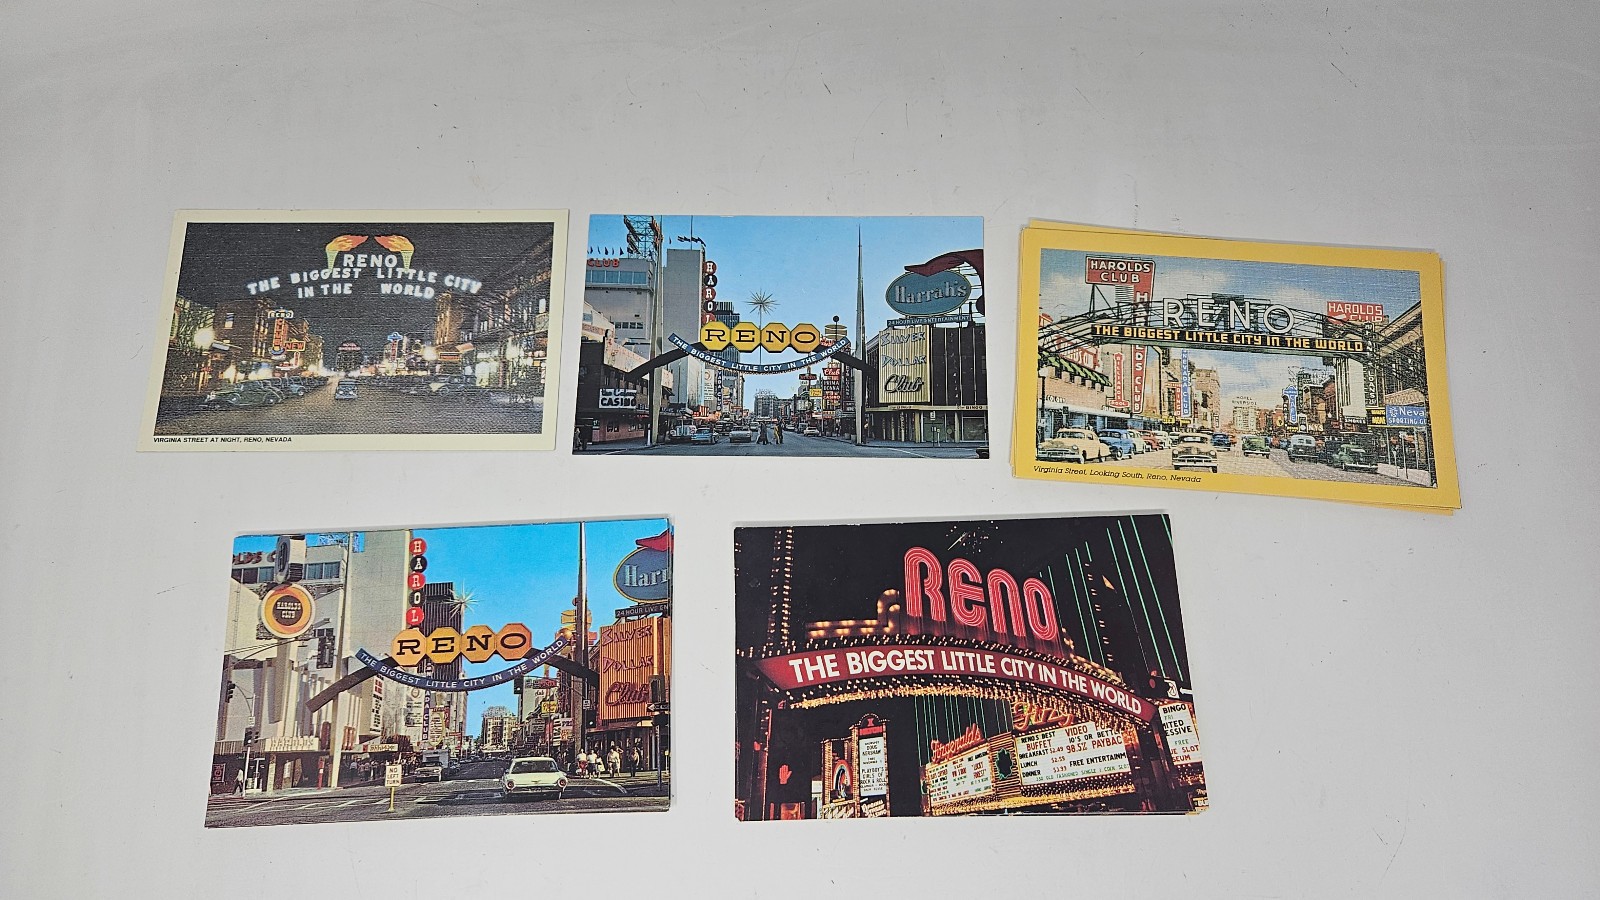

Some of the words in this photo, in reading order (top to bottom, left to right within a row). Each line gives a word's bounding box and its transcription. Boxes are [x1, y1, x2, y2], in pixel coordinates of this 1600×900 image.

[343, 254, 397, 268] RENO
[587, 258, 620, 268] CLUB
[1090, 260, 1151, 273] HAROLDS
[246, 277, 281, 295] THE
[290, 268, 361, 284] BIGGEST
[376, 268, 438, 283] LITTLE
[444, 275, 482, 294] CITY
[1100, 272, 1140, 283] CLUB
[297, 287, 315, 299] IN
[320, 283, 352, 295] THE
[381, 283, 436, 299] WORLD
[895, 280, 967, 304] Harrah's
[1328, 303, 1382, 315] HAROLDS
[1163, 298, 1295, 334] RENO
[705, 329, 816, 343] RENO
[1094, 325, 1120, 336] THE
[1124, 327, 1180, 340] BIGGEST
[1185, 331, 1229, 343] LITTLE
[1233, 334, 1262, 346] CITY
[1266, 336, 1280, 346] IN
[1285, 337, 1310, 348] THE
[1315, 339, 1364, 352] WORLD
[673, 336, 687, 350] THE
[690, 348, 727, 366] BIGGEST
[731, 362, 758, 372] LITTLE
[764, 364, 782, 372] CITY
[801, 356, 817, 366] THE
[820, 339, 847, 358] WORLD
[1134, 377, 1143, 411] CLUB
[600, 397, 637, 407] CASINO
[1399, 406, 1425, 417] Neva
[1033, 466, 1063, 474] Virginia
[1090, 469, 1120, 478] Looking
[1121, 471, 1144, 479] South,
[1170, 474, 1202, 483] Nevada
[617, 609, 625, 617] 24
[625, 607, 644, 616] HOUR
[601, 626, 653, 647] SILVER
[396, 632, 527, 656] RENO
[360, 652, 377, 668] THE
[380, 665, 421, 685] BIGGEST
[426, 679, 458, 689] LITTLE
[463, 677, 485, 687] CITY
[492, 673, 503, 682] IN
[508, 663, 528, 677] THE
[532, 639, 564, 664] WORLD
[602, 655, 654, 674] DOLLAR
[789, 654, 840, 683] THE
[846, 649, 936, 676] BIGGEST
[940, 651, 997, 674] LITTLE
[1000, 656, 1035, 680] CITY
[1038, 664, 1058, 685] IN
[1059, 669, 1088, 693] THE
[1090, 679, 1142, 715] WORLD
[1162, 703, 1187, 715] BINGO
[1041, 731, 1056, 740] BEST
[1064, 725, 1088, 737] VIDEO
[1165, 725, 1193, 737] ESSIVE
[1026, 739, 1052, 752] BUFFET
[1066, 742, 1088, 754] 98.5%
[1091, 735, 1123, 750] PAYBAC
[1182, 744, 1199, 753] SLOT
[1019, 749, 1049, 760] BREAKFAST
[1020, 761, 1038, 769] LUNCH
[1069, 759, 1085, 768] FREE
[1022, 769, 1041, 778] DINNER
